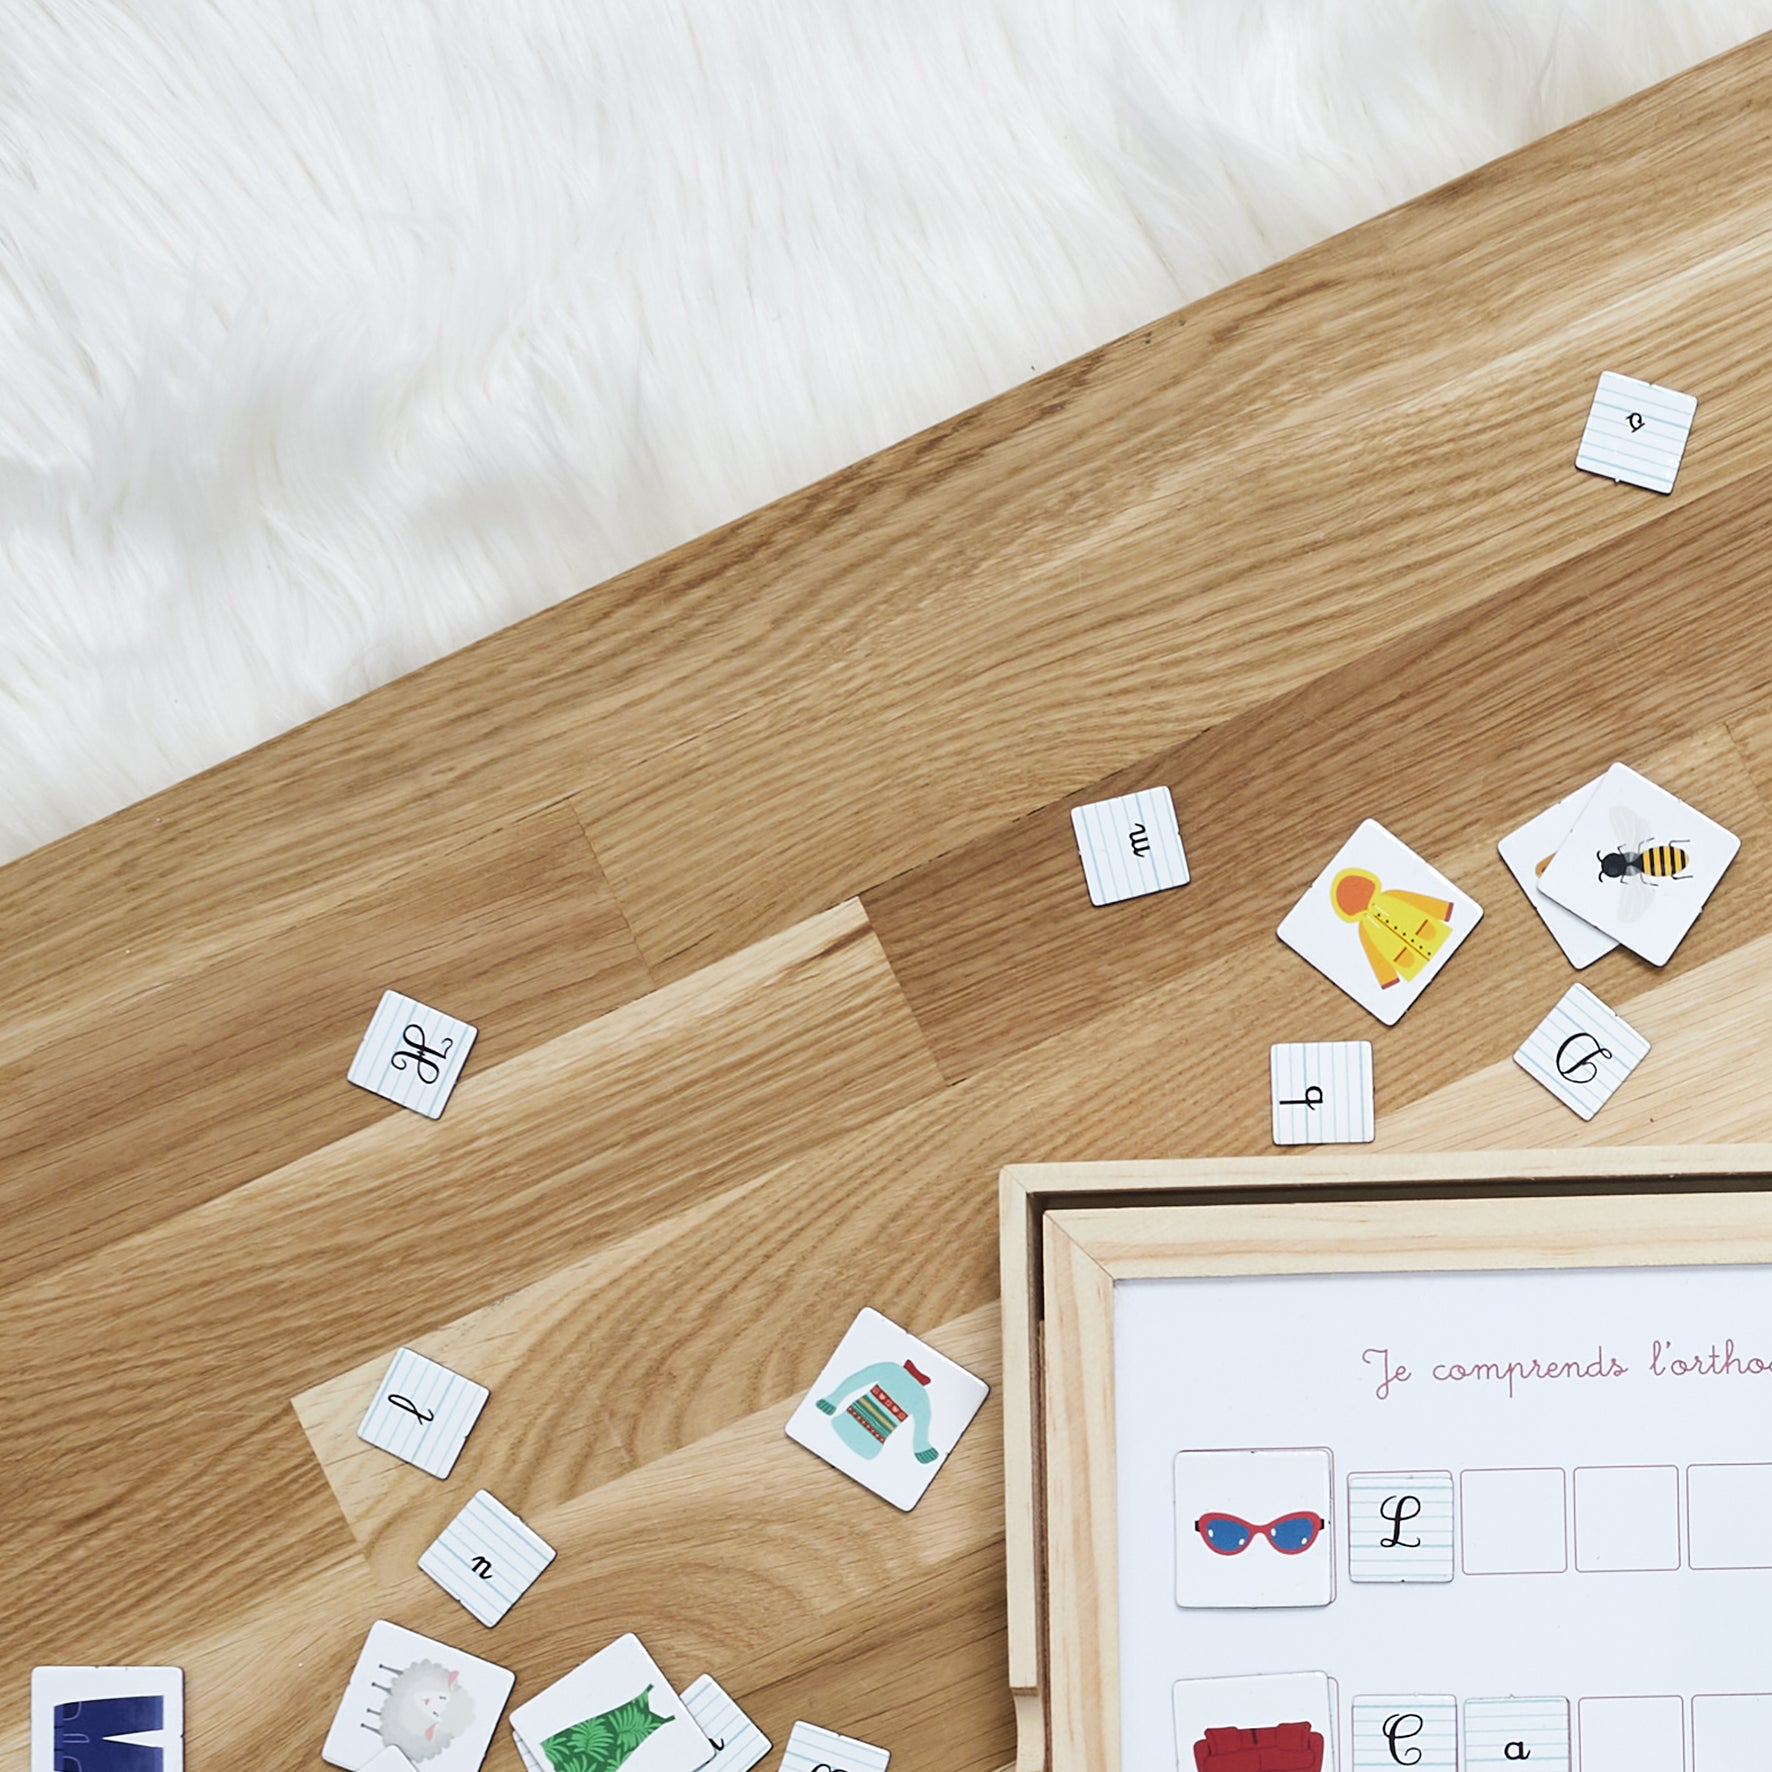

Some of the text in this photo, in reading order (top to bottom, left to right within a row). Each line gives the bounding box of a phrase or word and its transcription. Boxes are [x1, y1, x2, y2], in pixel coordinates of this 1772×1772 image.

[391, 1024, 453, 1084] H
[1556, 1032, 1613, 1082] D
[1362, 1347, 1412, 1400] Je
[1432, 1344, 1629, 1399] comprends
[1379, 1495, 1421, 1548] L
